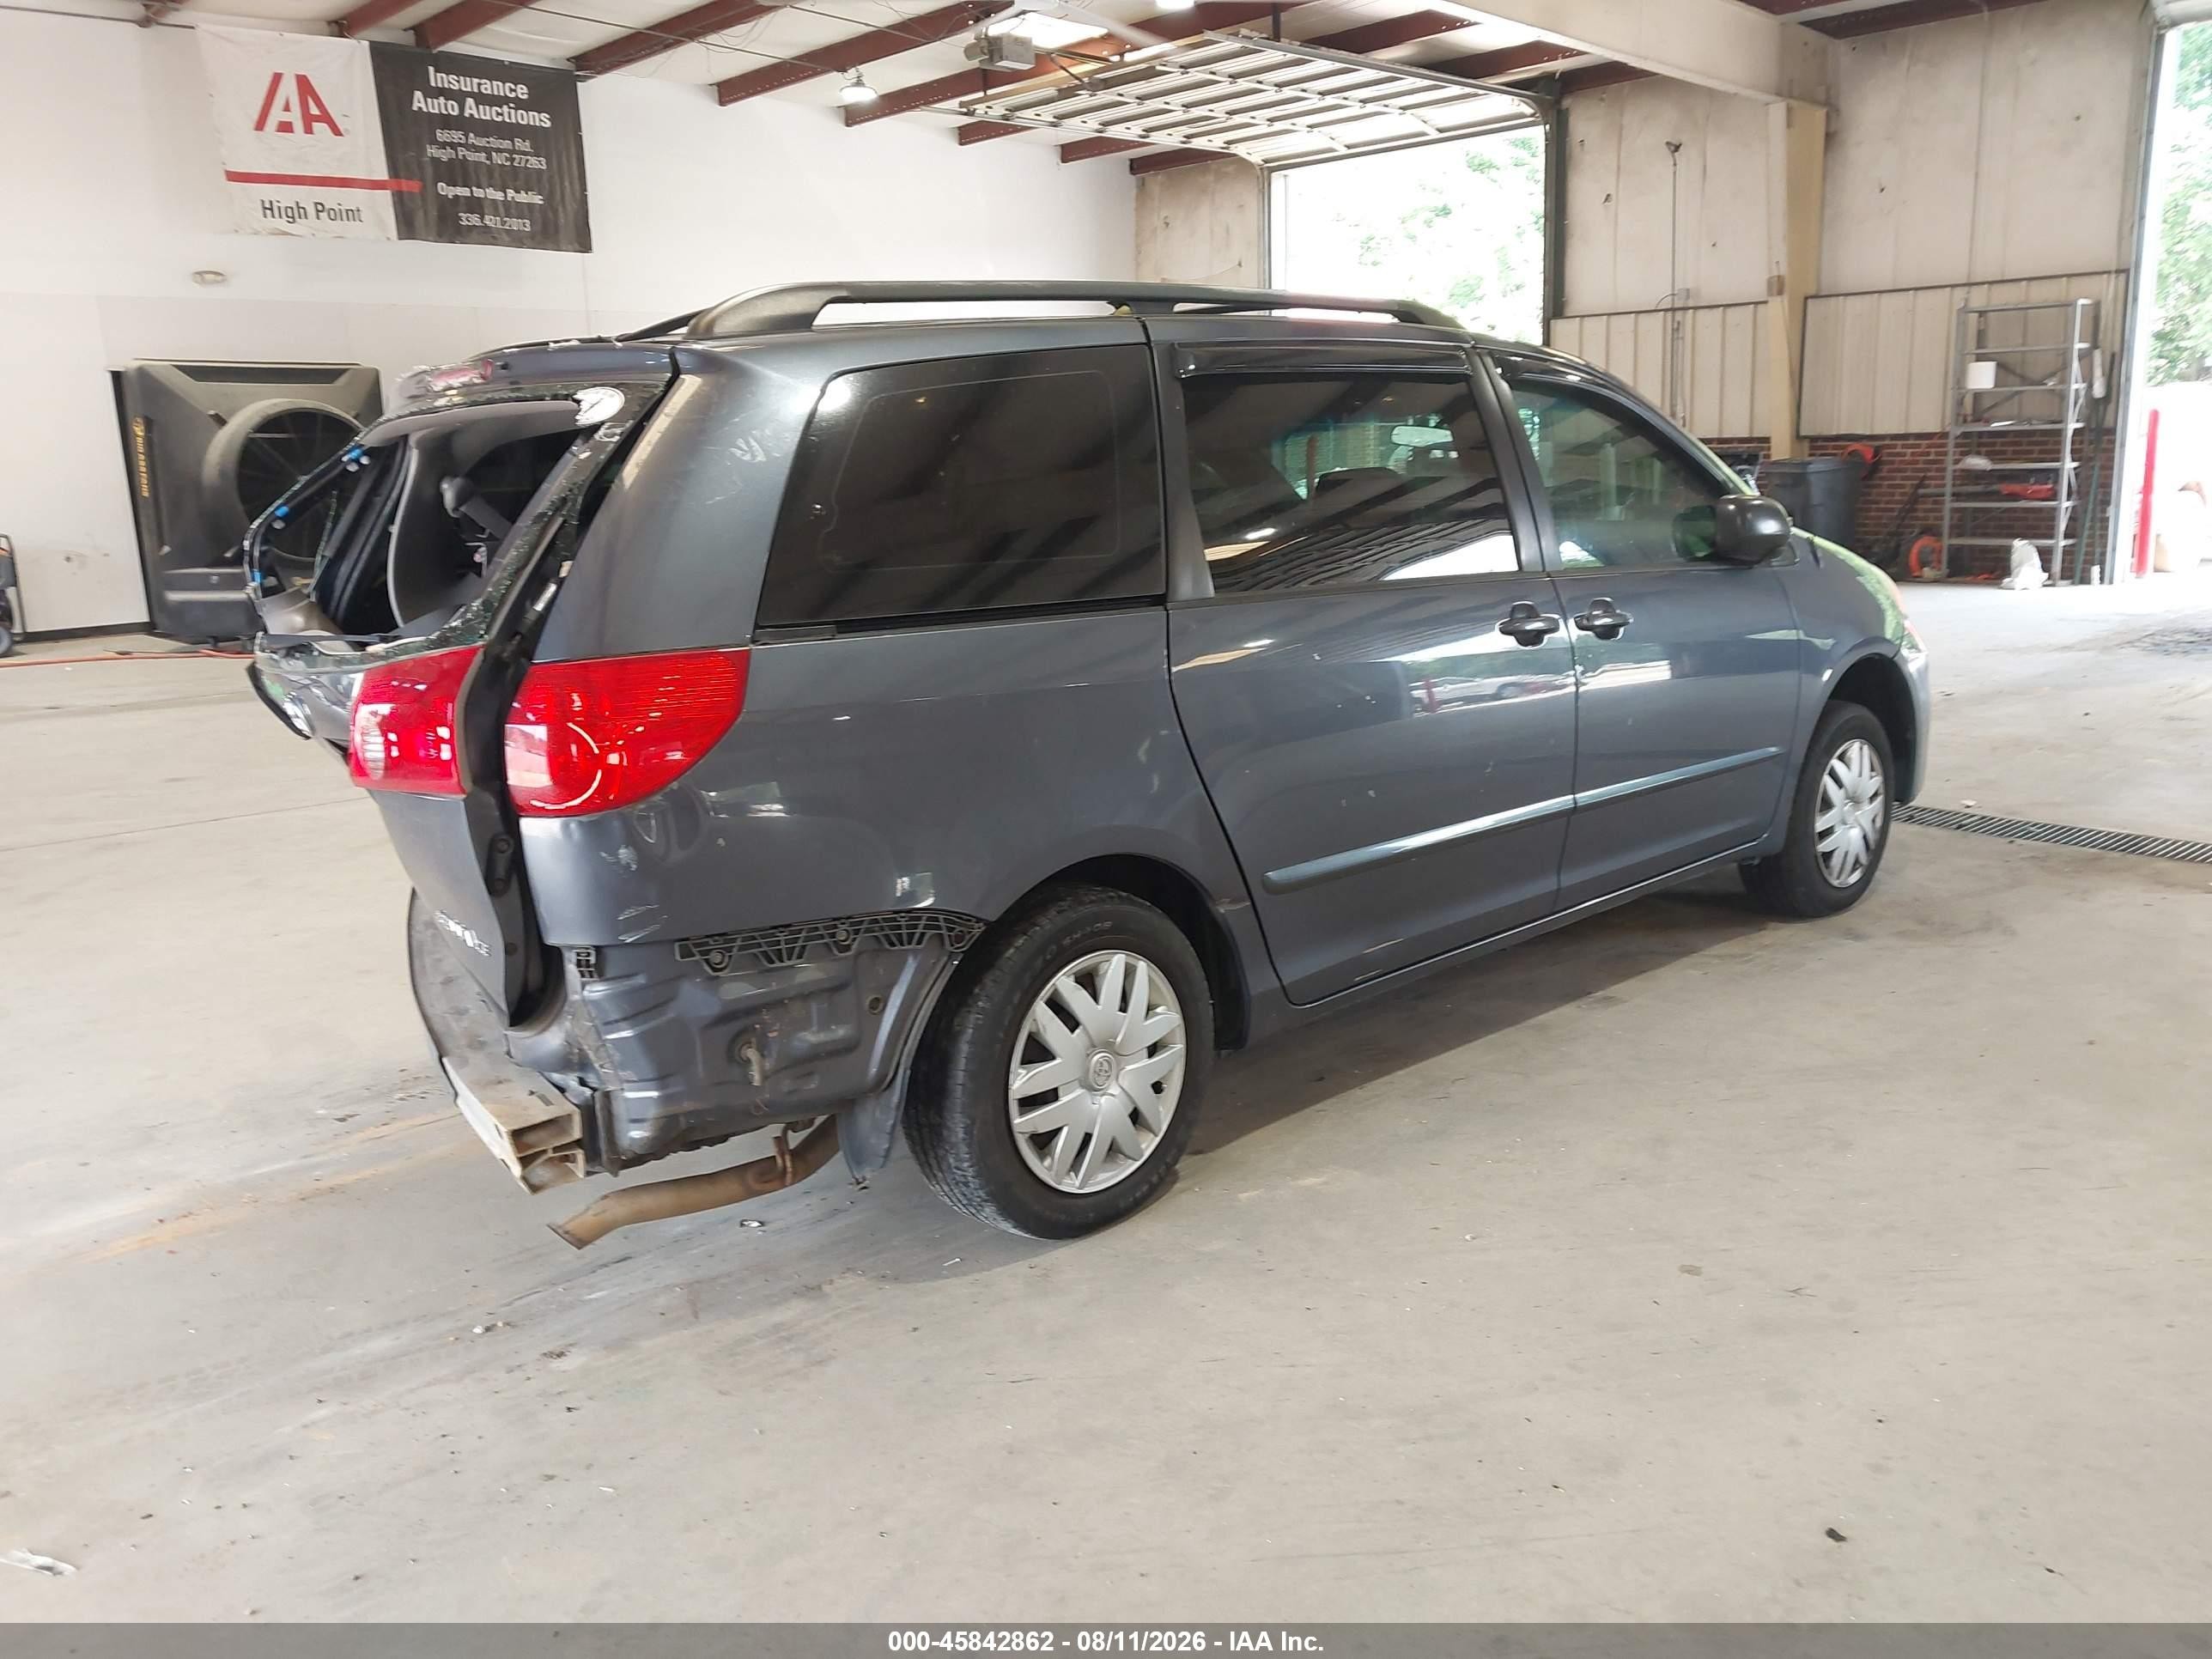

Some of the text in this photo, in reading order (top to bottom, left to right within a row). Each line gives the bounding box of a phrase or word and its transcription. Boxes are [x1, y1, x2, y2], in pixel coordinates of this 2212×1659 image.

[428, 65, 529, 100] Insurance
[411, 90, 552, 128] Auto Auctions
[467, 132, 514, 149] Auction
[426, 144, 456, 161] High
[490, 151, 511, 166] NC
[437, 182, 544, 204] Open to the Public
[260, 198, 364, 224] High Point
